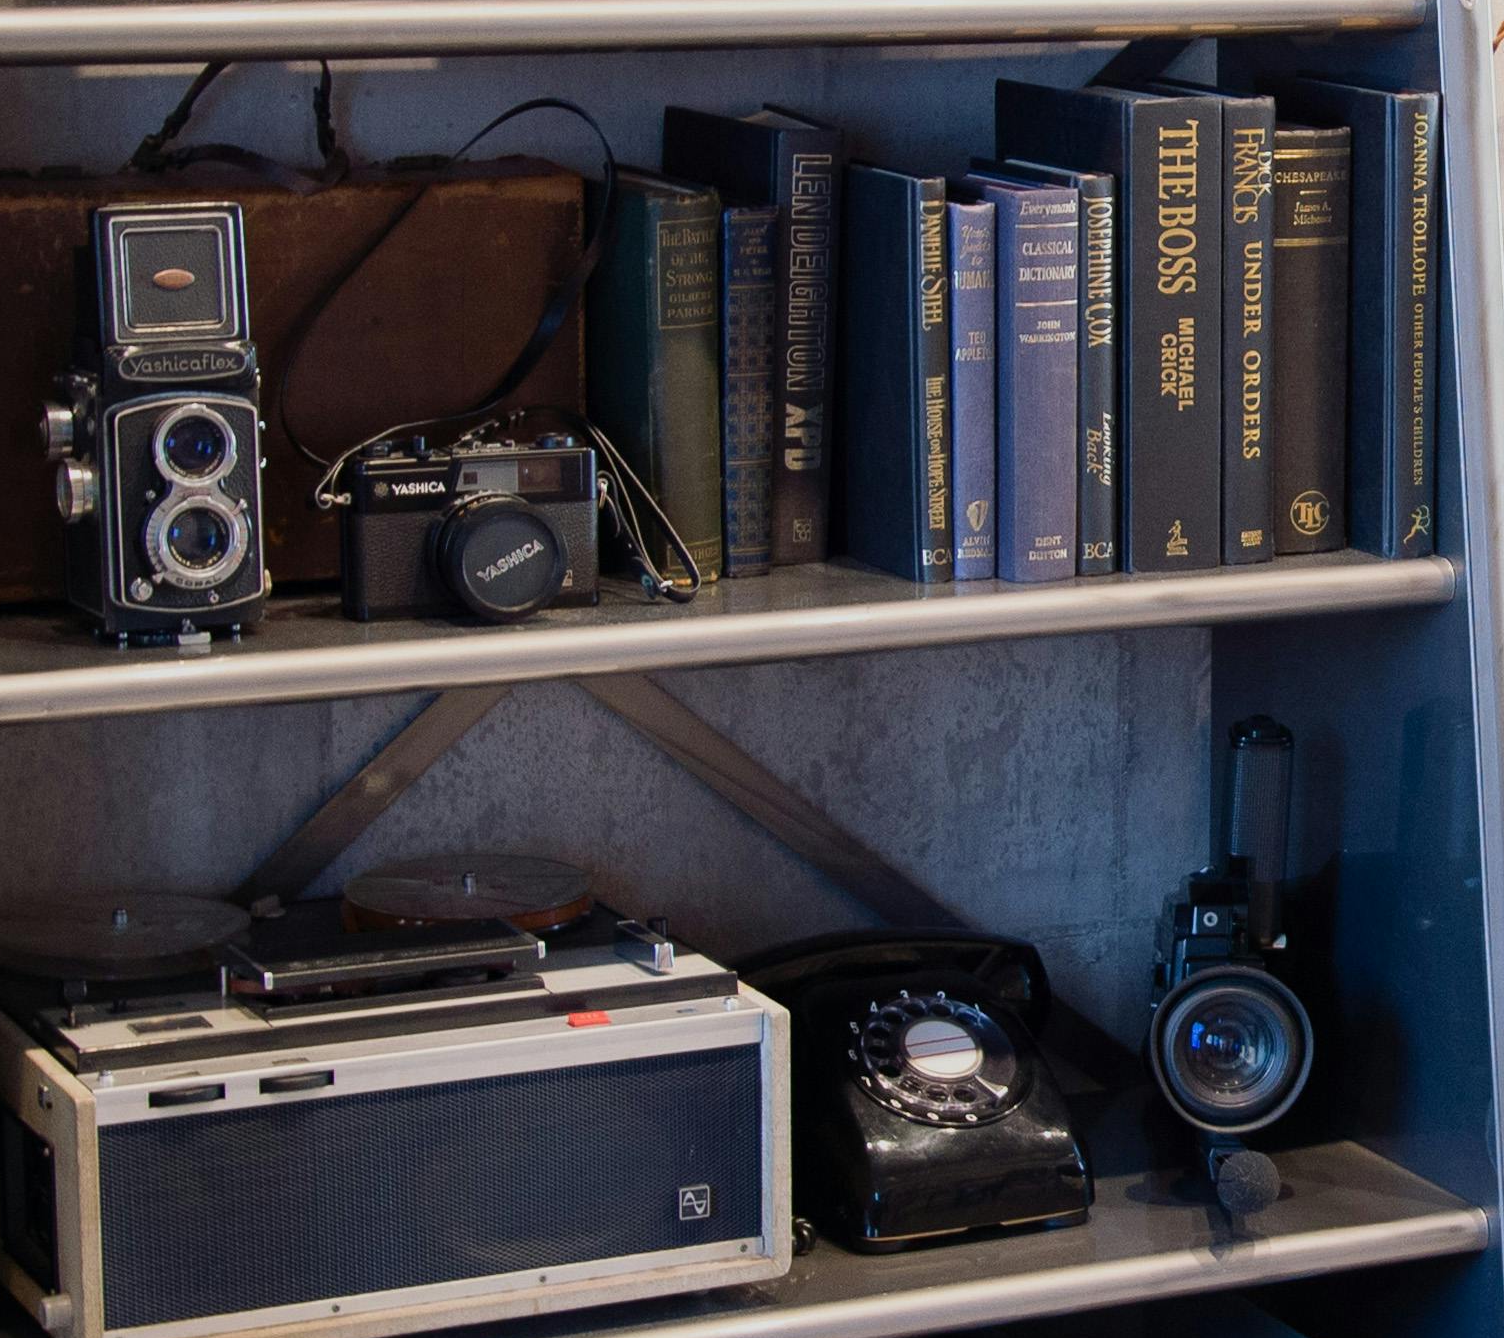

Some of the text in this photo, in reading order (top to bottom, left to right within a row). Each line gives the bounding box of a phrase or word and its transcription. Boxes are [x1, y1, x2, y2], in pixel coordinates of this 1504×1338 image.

[791, 154, 832, 219] LEN
[1232, 127, 1267, 226] FRANCIS
[1257, 150, 1273, 196] DICK
[1273, 171, 1349, 185] CHESAPEAKE
[1157, 118, 1200, 296] THE BOSS
[1411, 111, 1428, 298] JOANNA TROLLOPE
[1022, 239, 1074, 256] CLASSICAL
[1018, 264, 1077, 282] DICTIONARY
[1082, 195, 1115, 349] JOSEPHINE COX
[920, 274, 948, 332] STEEL
[1036, 319, 1061, 330] JOHN
[1019, 331, 1076, 344] WARRINGTON
[1242, 240, 1263, 460] UNDER ORDERS
[128, 353, 238, 377] Yashicaflex
[1161, 332, 1178, 397] CRICK
[1177, 316, 1195, 412] MICHAEL
[1412, 302, 1425, 487] OTHER PEOPLE'S CHILDREN
[784, 402, 824, 471] XPD
[926, 399, 946, 439] HOUSE
[391, 480, 446, 497] YASHICA
[928, 487, 948, 530] STREET
[475, 538, 545, 583] YASHICA
[922, 548, 953, 565] BCA
[1028, 548, 1068, 561] DUTTON
[1034, 534, 1063, 547] DENT
[1082, 541, 1115, 560] BCA
